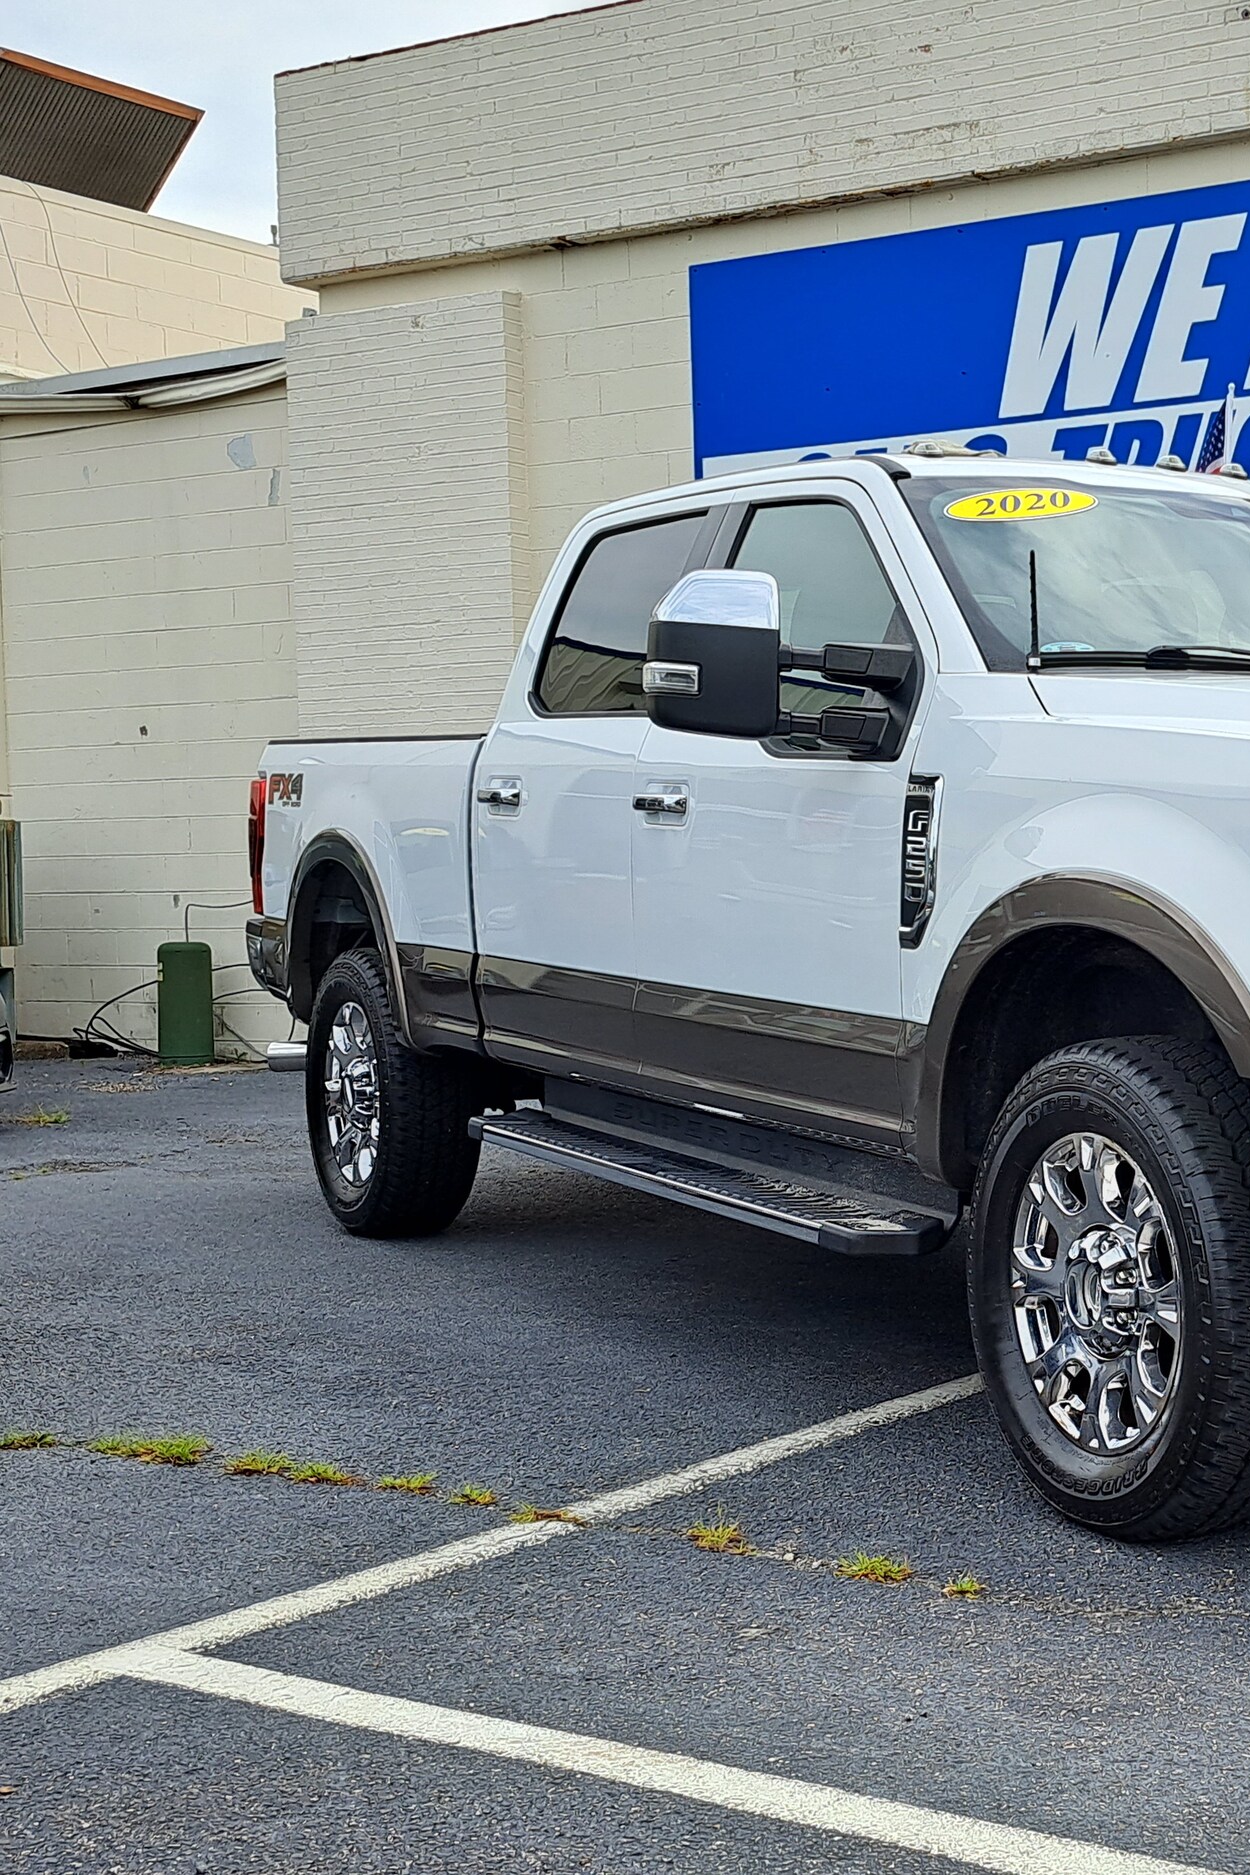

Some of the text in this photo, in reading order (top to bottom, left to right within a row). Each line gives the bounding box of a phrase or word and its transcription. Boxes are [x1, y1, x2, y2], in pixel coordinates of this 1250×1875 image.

[998, 212, 1248, 419] WE
[975, 491, 1071, 517] 2020
[268, 773, 304, 805] FX4
[613, 1102, 842, 1171] SUPER DUTY
